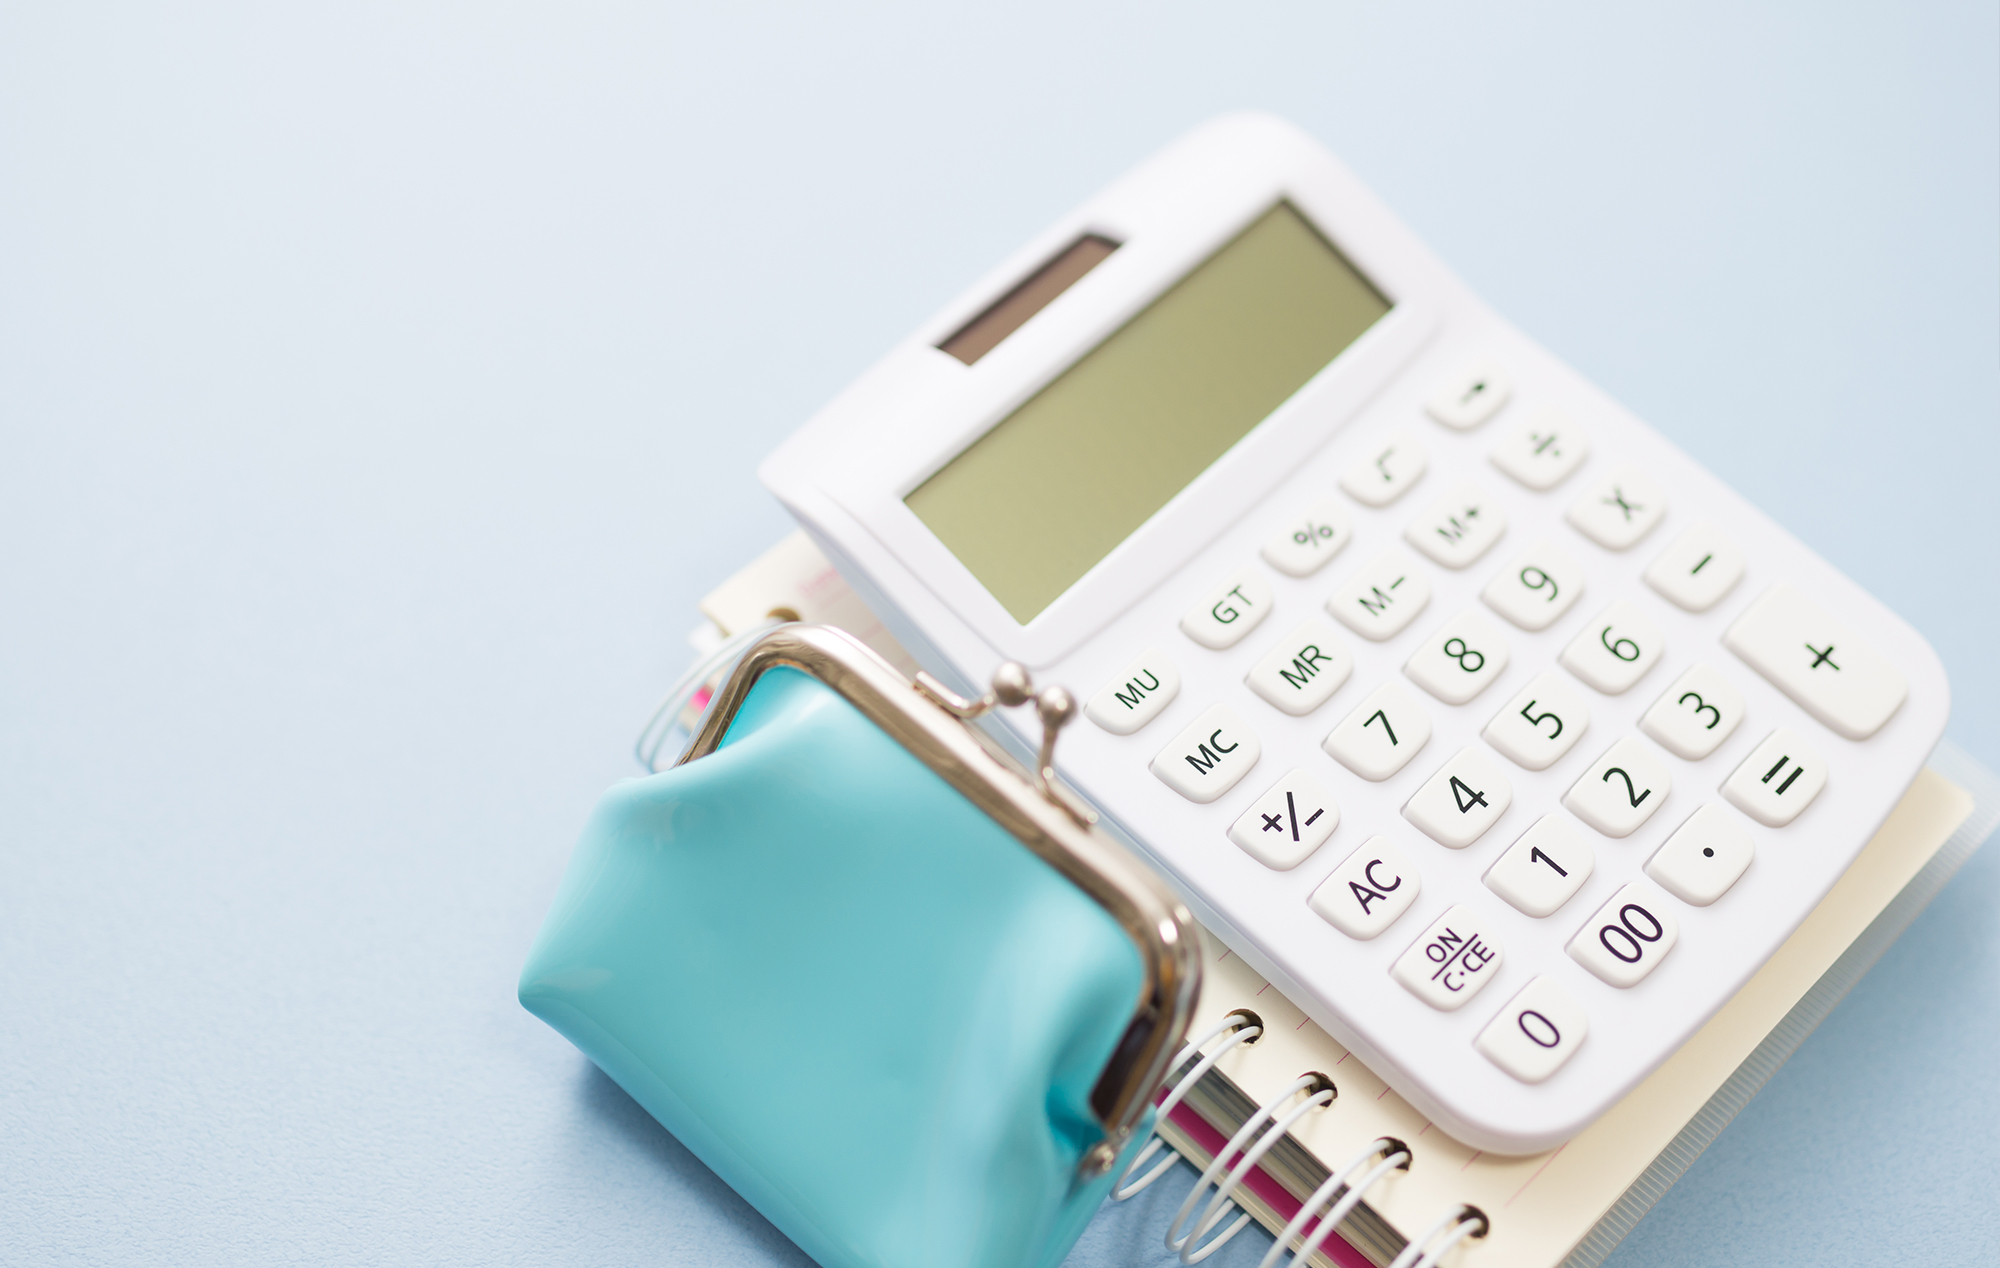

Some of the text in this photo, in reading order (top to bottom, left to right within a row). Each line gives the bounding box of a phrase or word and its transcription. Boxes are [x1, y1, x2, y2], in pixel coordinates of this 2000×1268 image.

[1292, 523, 1334, 548] %
[1520, 567, 1558, 601] 9
[1211, 584, 1253, 625] GT
[1444, 638, 1485, 672] 8
[1602, 627, 1640, 661] 6
[1806, 644, 1839, 670] +
[1279, 645, 1332, 689] MR
[1114, 668, 1160, 710] MU
[1363, 710, 1398, 746] 7
[1521, 700, 1563, 739] 5
[1679, 692, 1720, 729] 3
[1184, 728, 1239, 776] MC
[1449, 776, 1488, 814] 4
[1603, 768, 1651, 808] 2
[1531, 846, 1568, 877] 1
[1347, 858, 1402, 915] AC
[1425, 927, 1463, 963] ON
[1598, 903, 1664, 964] 00
[1518, 1010, 1560, 1048] 0
